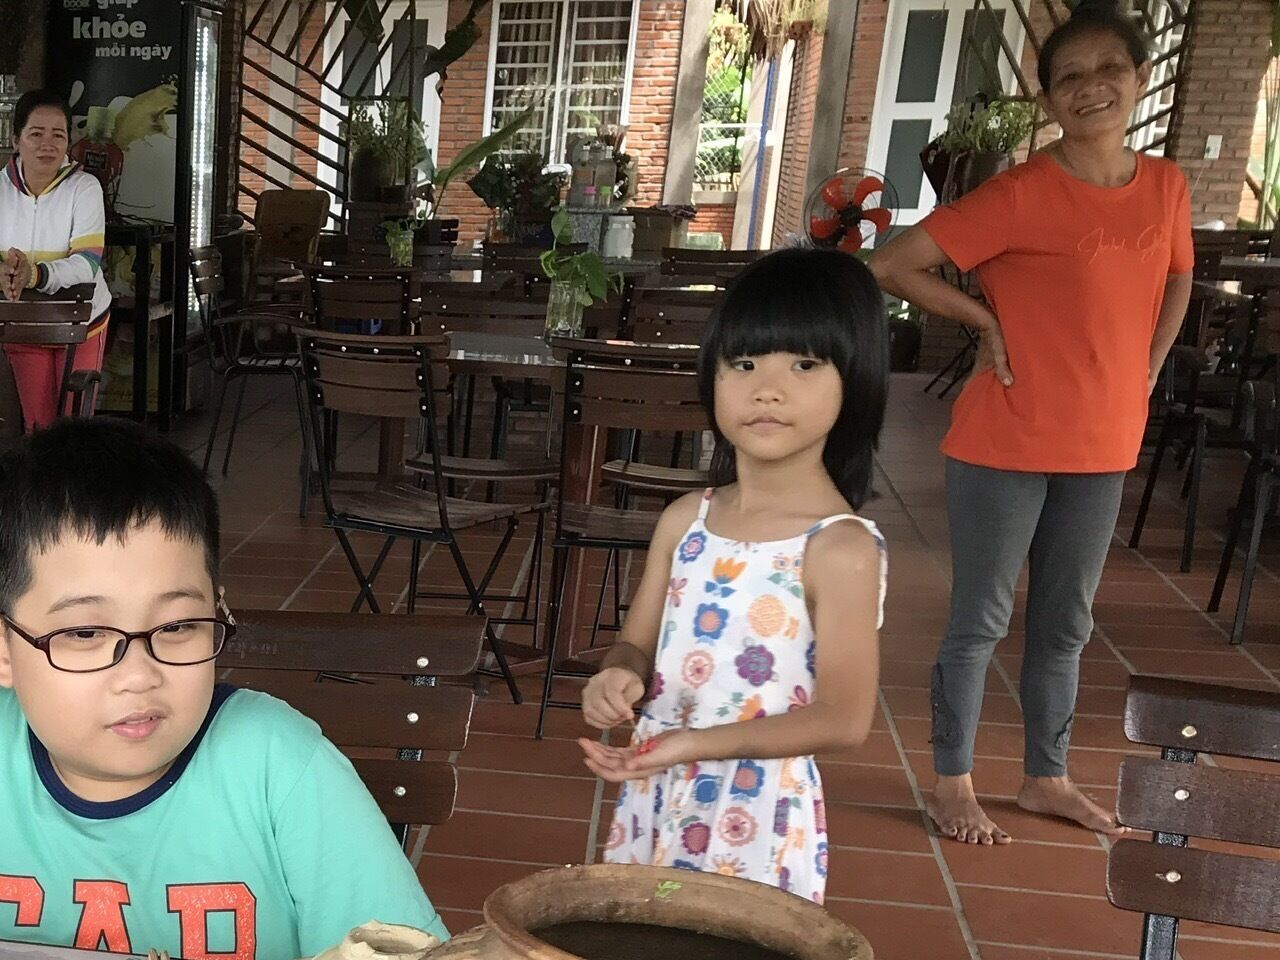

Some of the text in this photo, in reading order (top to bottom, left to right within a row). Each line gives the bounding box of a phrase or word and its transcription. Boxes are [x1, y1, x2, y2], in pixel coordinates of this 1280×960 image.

[73, 13, 147, 39] khỏe
[95, 42, 172, 60] mỗi ngày
